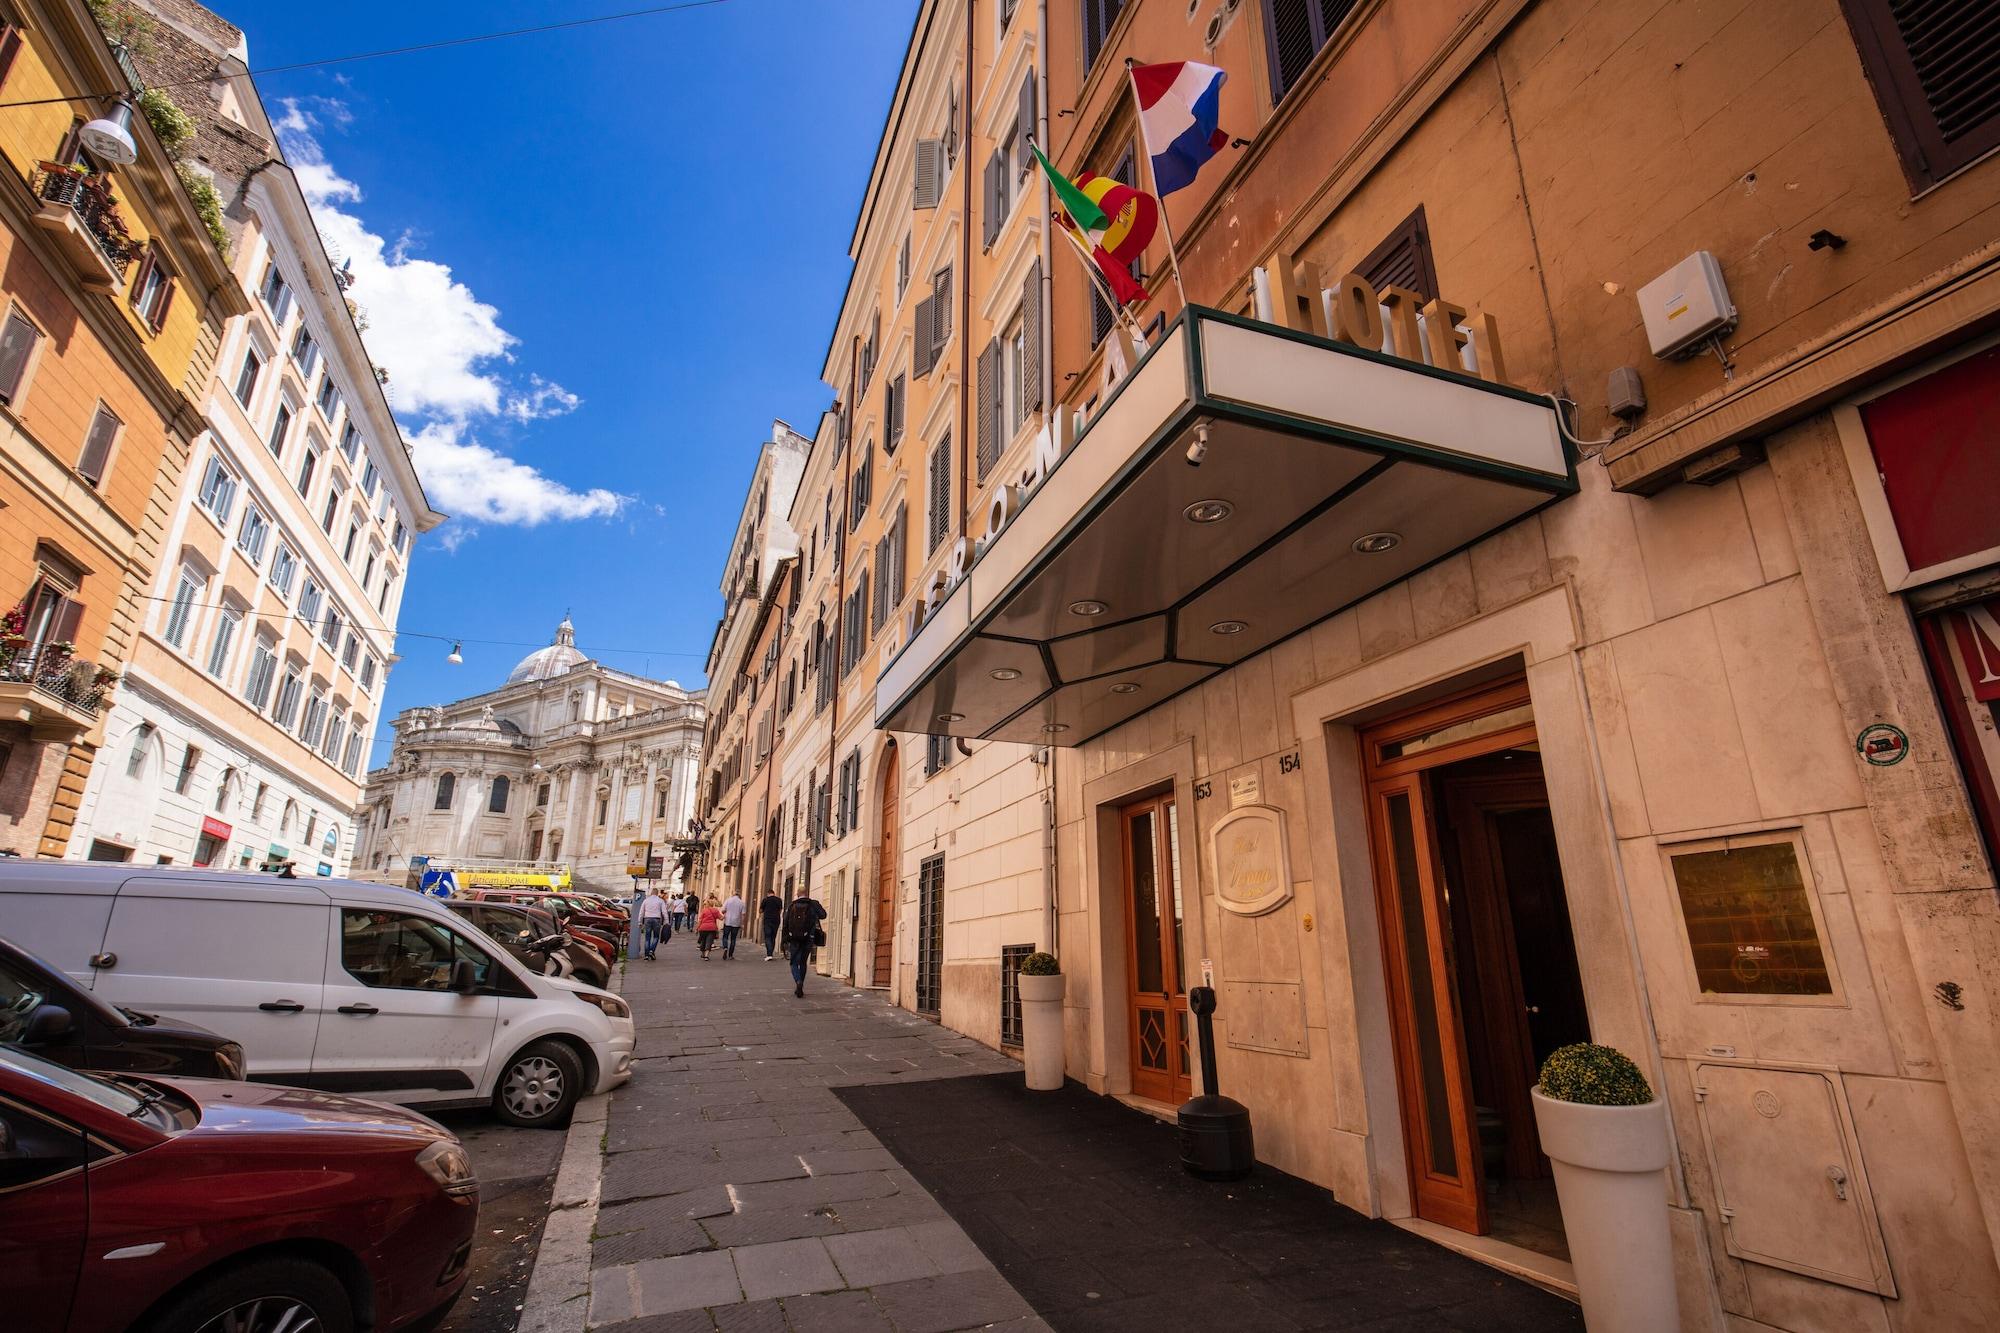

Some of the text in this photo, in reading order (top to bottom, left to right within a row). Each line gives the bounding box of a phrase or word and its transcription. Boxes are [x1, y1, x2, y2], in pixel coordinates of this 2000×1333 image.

[1266, 252, 1527, 392] HOTEL
[906, 327, 1140, 640] VERONA
[1194, 781, 1212, 801] 153
[1279, 752, 1301, 775] 154
